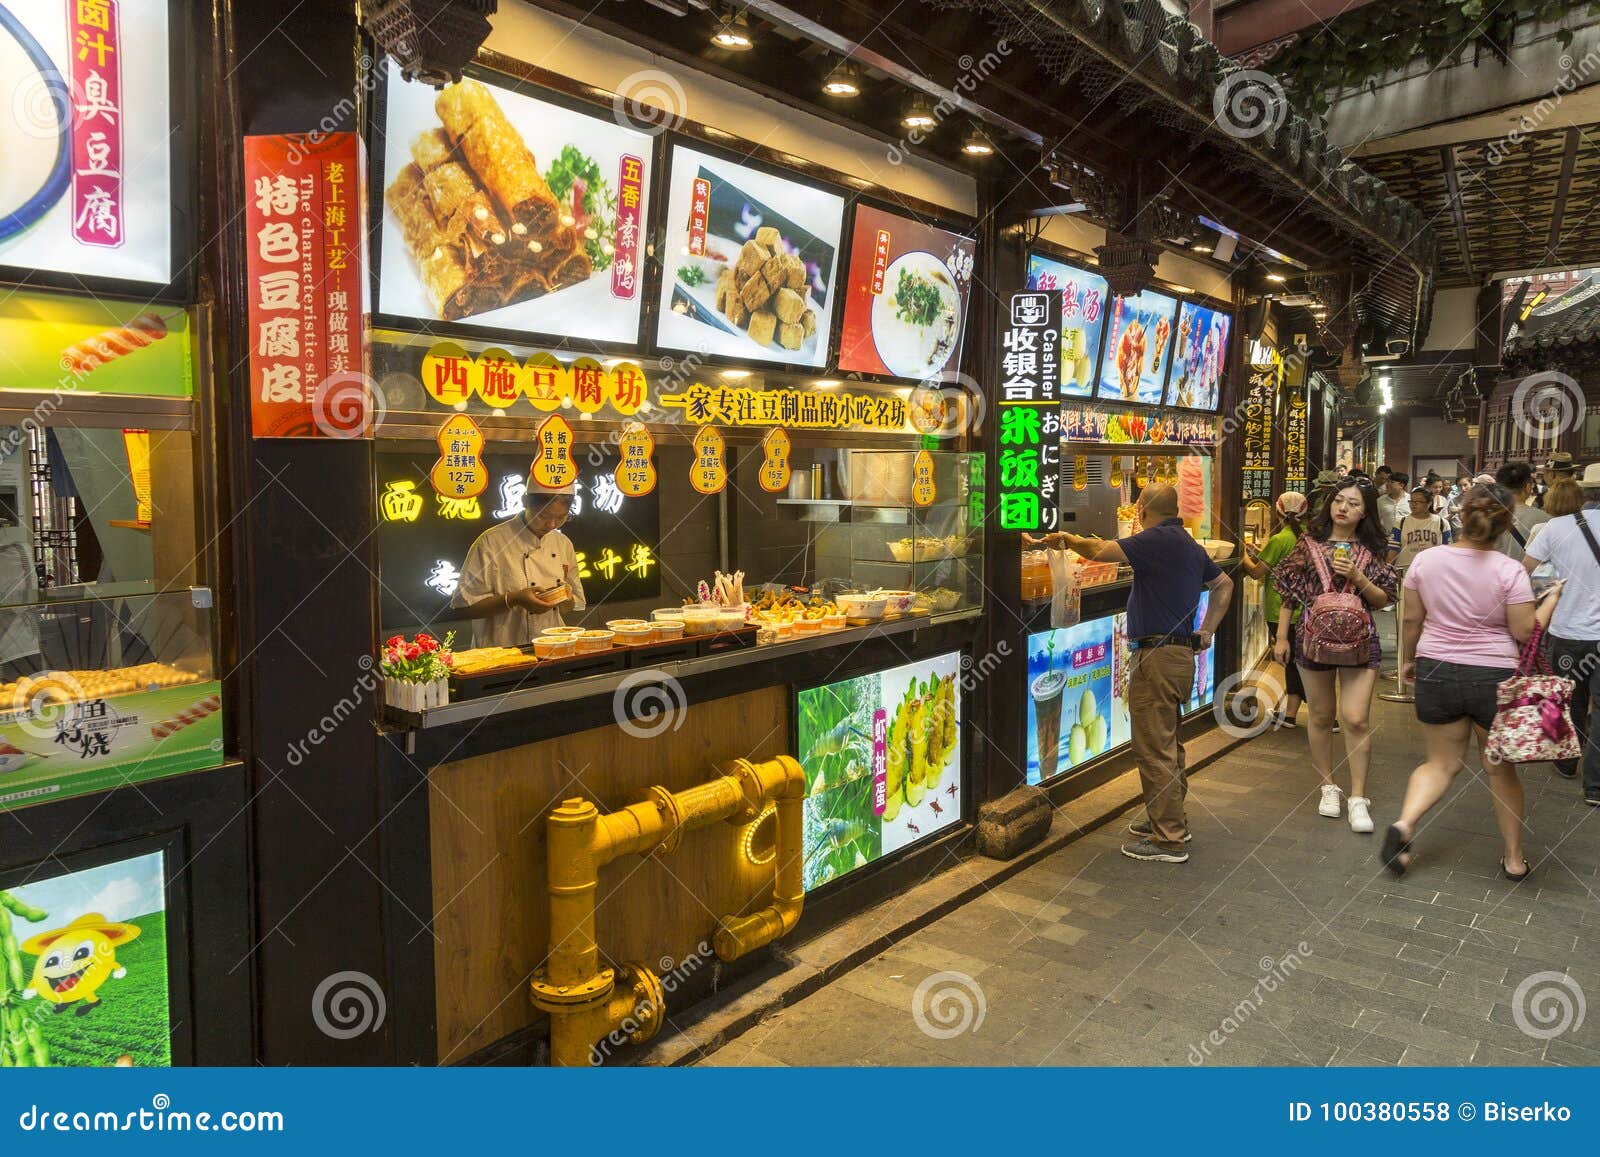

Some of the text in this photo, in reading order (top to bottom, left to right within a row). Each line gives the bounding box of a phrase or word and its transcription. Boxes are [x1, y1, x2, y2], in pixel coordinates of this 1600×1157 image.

[614, 159, 641, 290] 五香素鸭
[254, 174, 303, 403] 特色豆腐皮
[300, 174, 319, 404] The characteristic skin
[1002, 327, 1039, 400] 收银台
[1042, 329, 1058, 400] Cashier
[433, 354, 643, 408] 西施豆腐坊
[662, 387, 905, 427] 一家专注豆制品的小吃名坊
[544, 431, 567, 444] 铁板
[451, 440, 471, 453] 卤汁
[629, 446, 644, 456] 陕西
[544, 447, 567, 460] 豆腐
[446, 455, 476, 468] 五香素鸭
[1000, 406, 1039, 529] 米饭团
[545, 464, 567, 474] 10元
[703, 471, 716, 480] 8元
[768, 471, 783, 479] 15元
[1041, 411, 1059, 531] おにぎり
[448, 471, 475, 483] 12元
[549, 476, 561, 485] /客
[627, 472, 647, 482] 12元
[456, 484, 465, 494] 条
